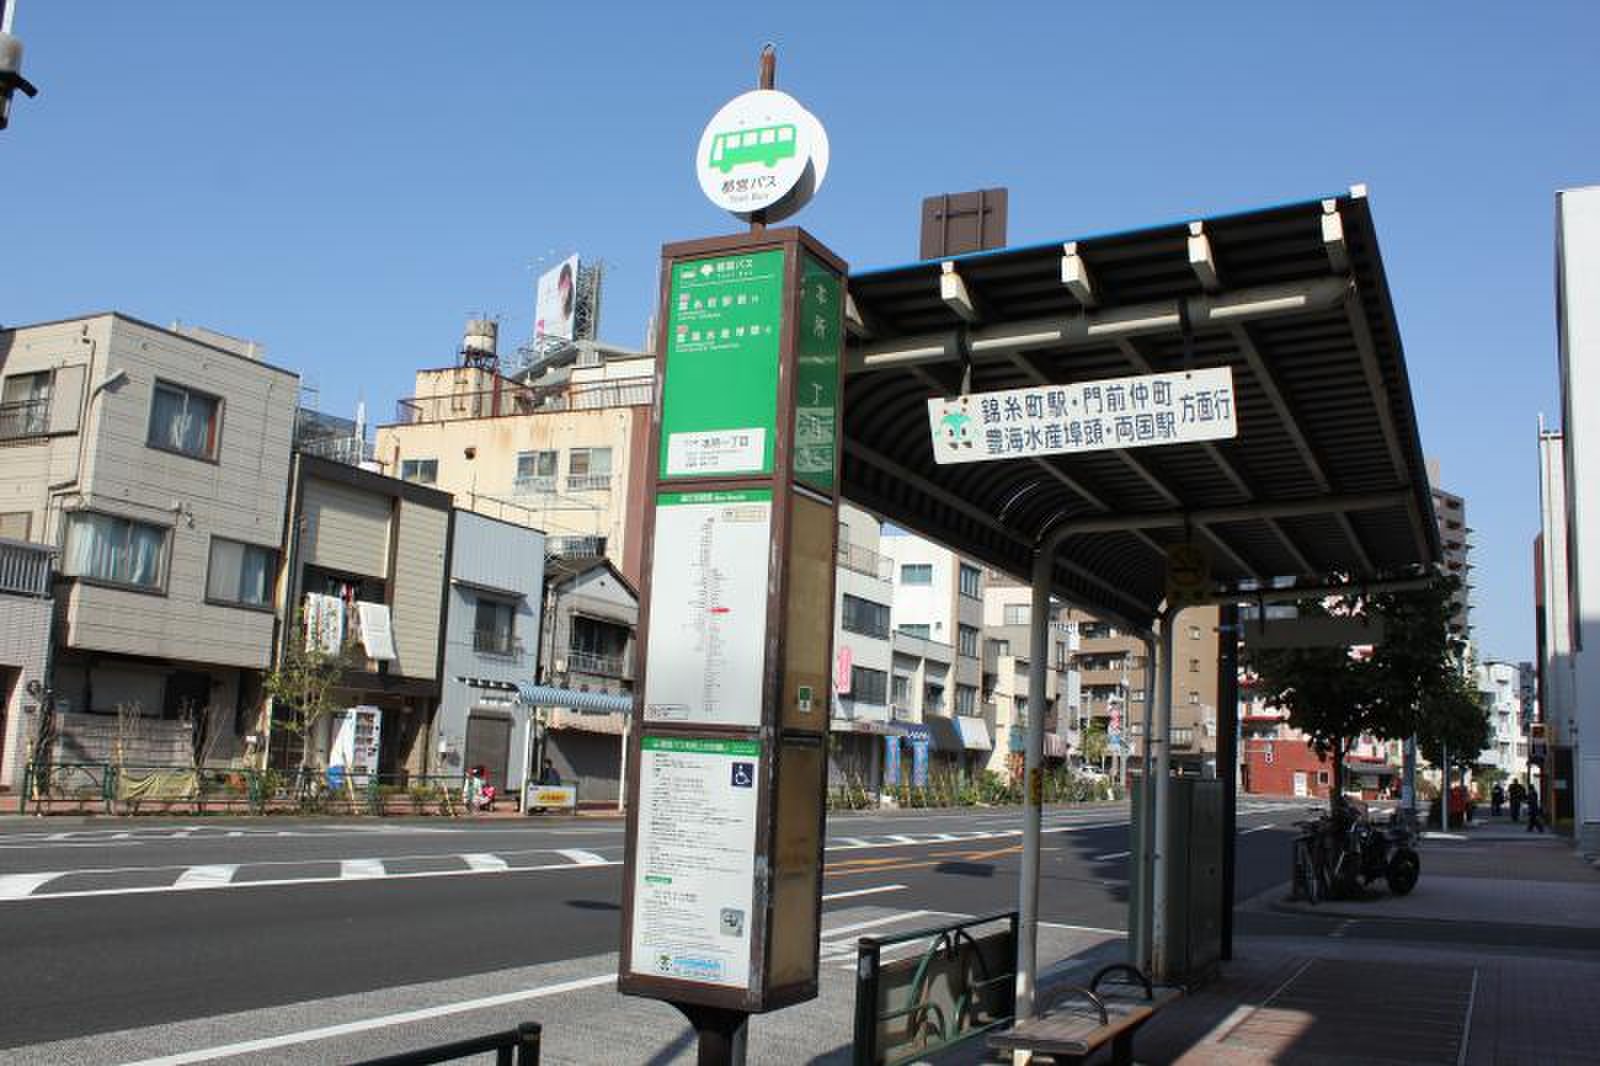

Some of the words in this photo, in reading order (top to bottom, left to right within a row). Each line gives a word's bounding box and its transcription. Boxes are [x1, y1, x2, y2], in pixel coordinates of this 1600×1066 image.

[720, 175, 777, 193] 都営バス
[981, 380, 1173, 425] 錦糸町駅・門前仲町
[1180, 388, 1230, 423] 方面行
[985, 411, 1178, 455] 豊海水産埠頭・両国駅
